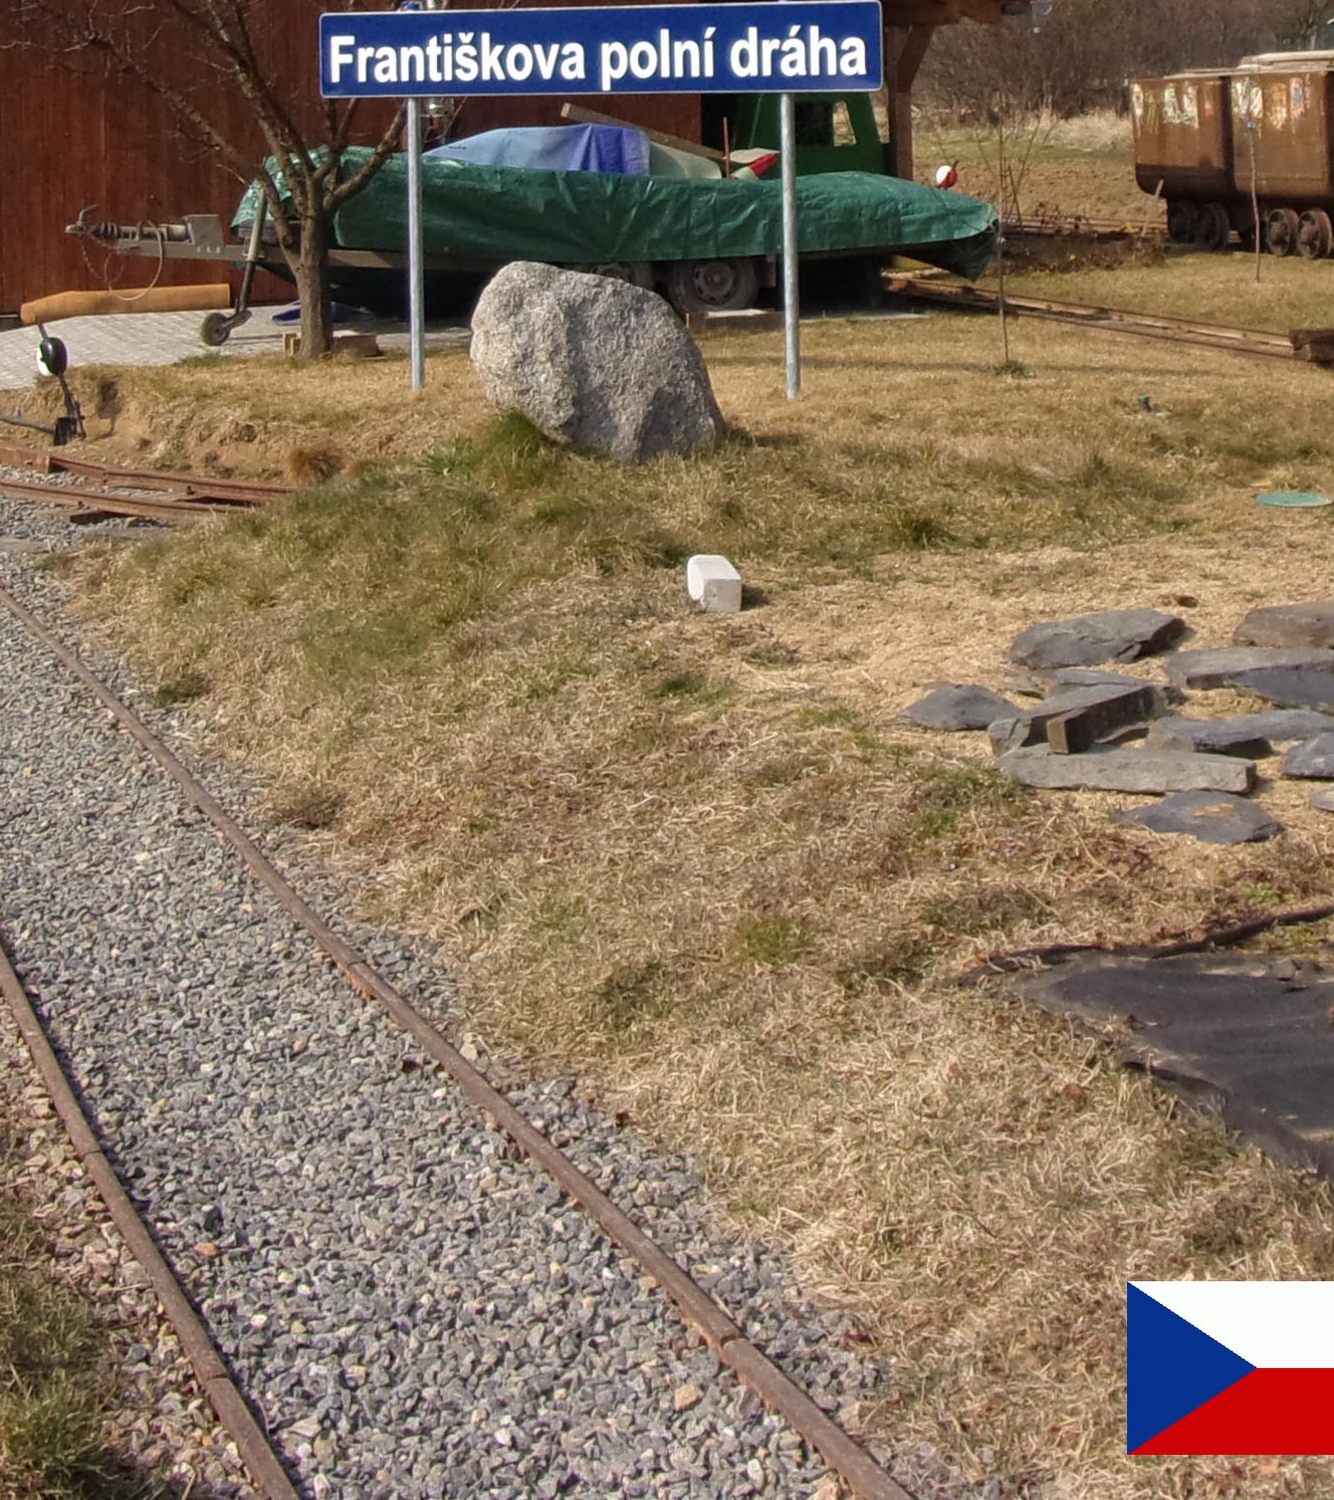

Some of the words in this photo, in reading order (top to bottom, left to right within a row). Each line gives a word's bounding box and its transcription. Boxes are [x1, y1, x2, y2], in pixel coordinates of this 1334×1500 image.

[330, 30, 585, 84] Františkova
[601, 26, 717, 91] polní
[730, 24, 867, 77] dráha
